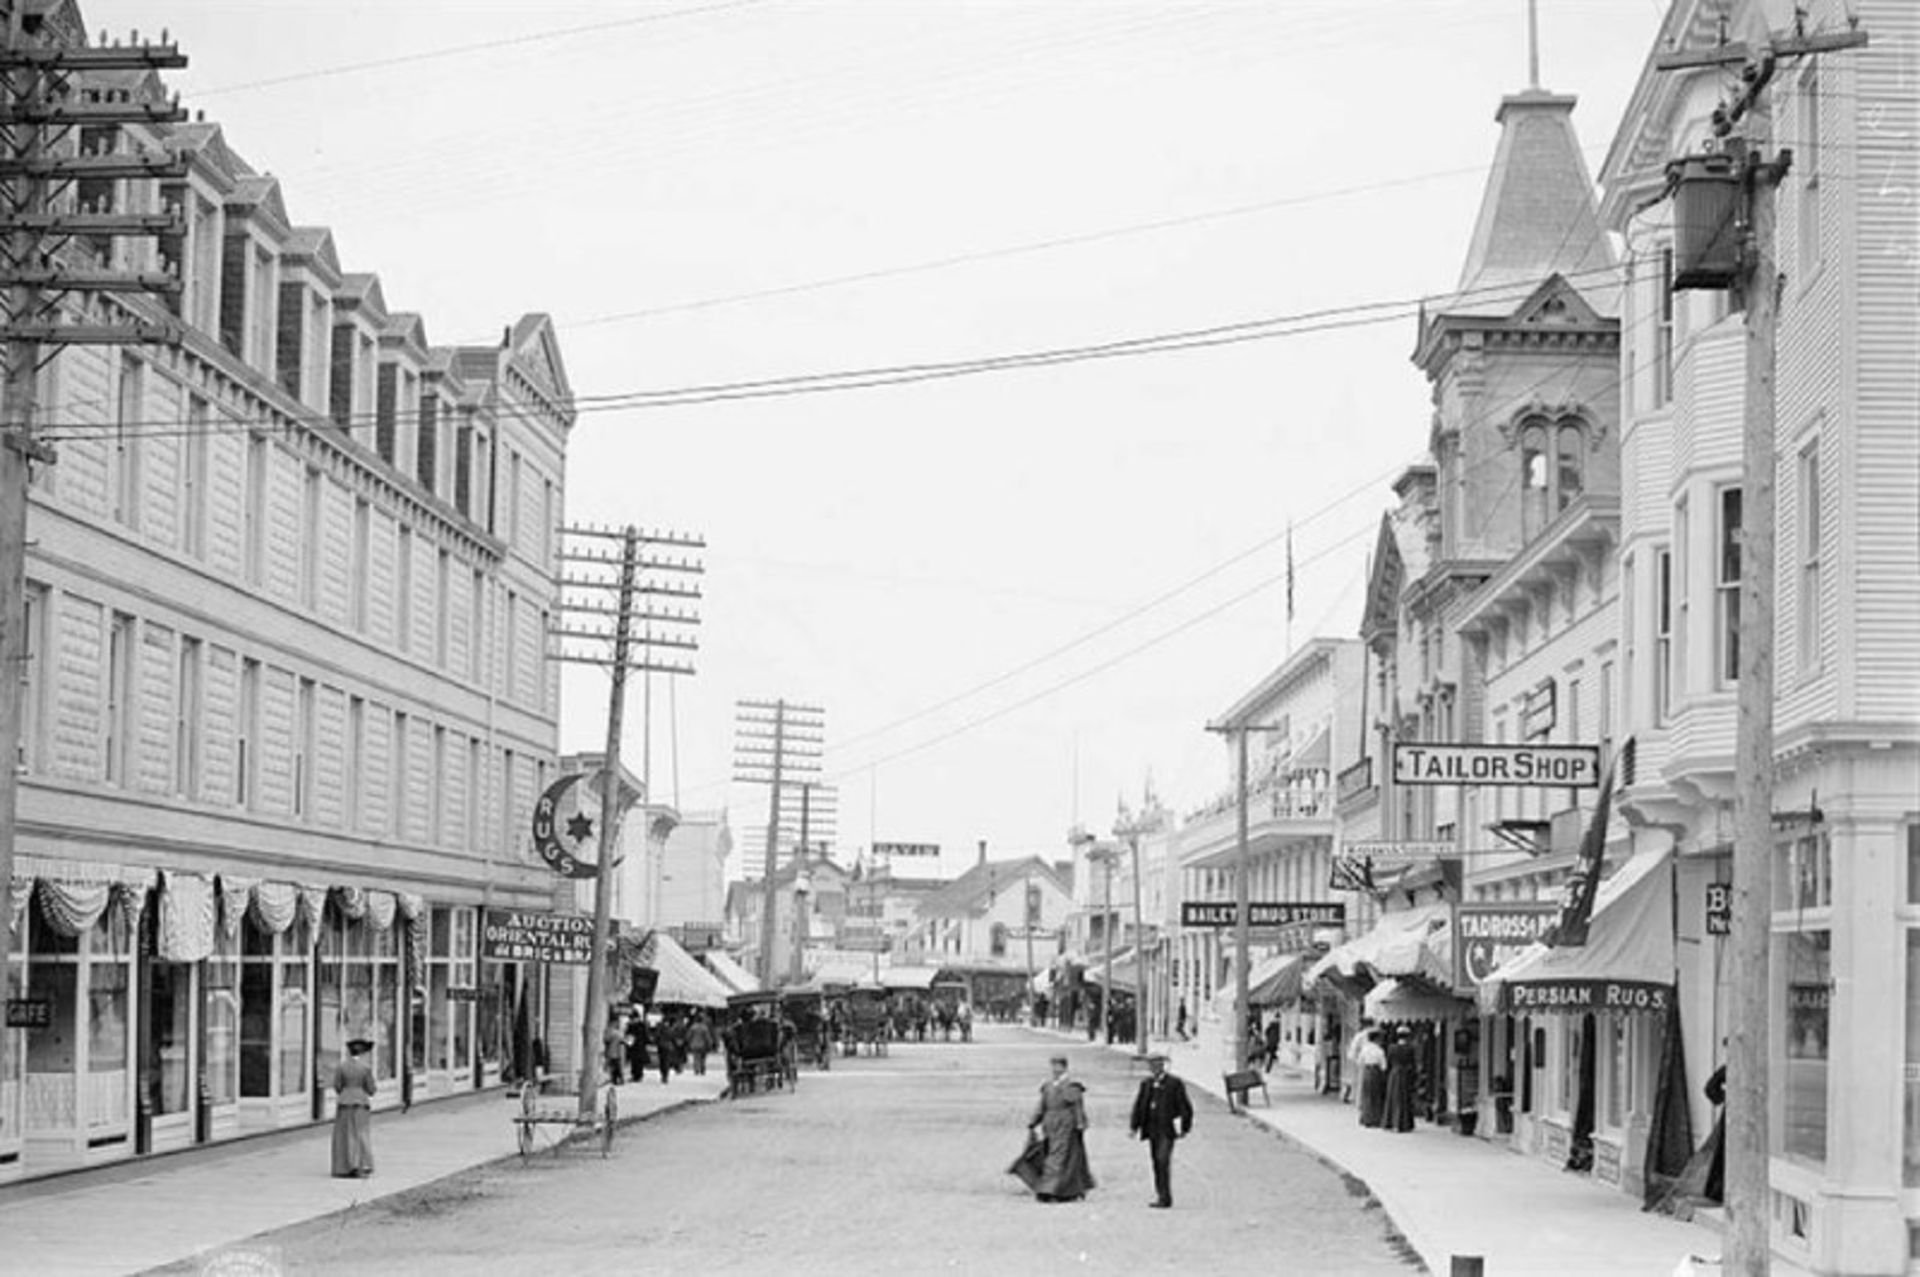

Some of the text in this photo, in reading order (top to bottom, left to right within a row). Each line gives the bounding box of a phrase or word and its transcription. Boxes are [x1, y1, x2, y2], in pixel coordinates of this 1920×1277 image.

[1407, 750, 1587, 781] TAILOR SHOP
[536, 797, 574, 875] RUGS
[507, 914, 594, 934] AUCTION
[1251, 907, 1289, 923] DRUG
[487, 926, 571, 947] ORIENTAL
[1513, 985, 1592, 1006] PERSIAN
